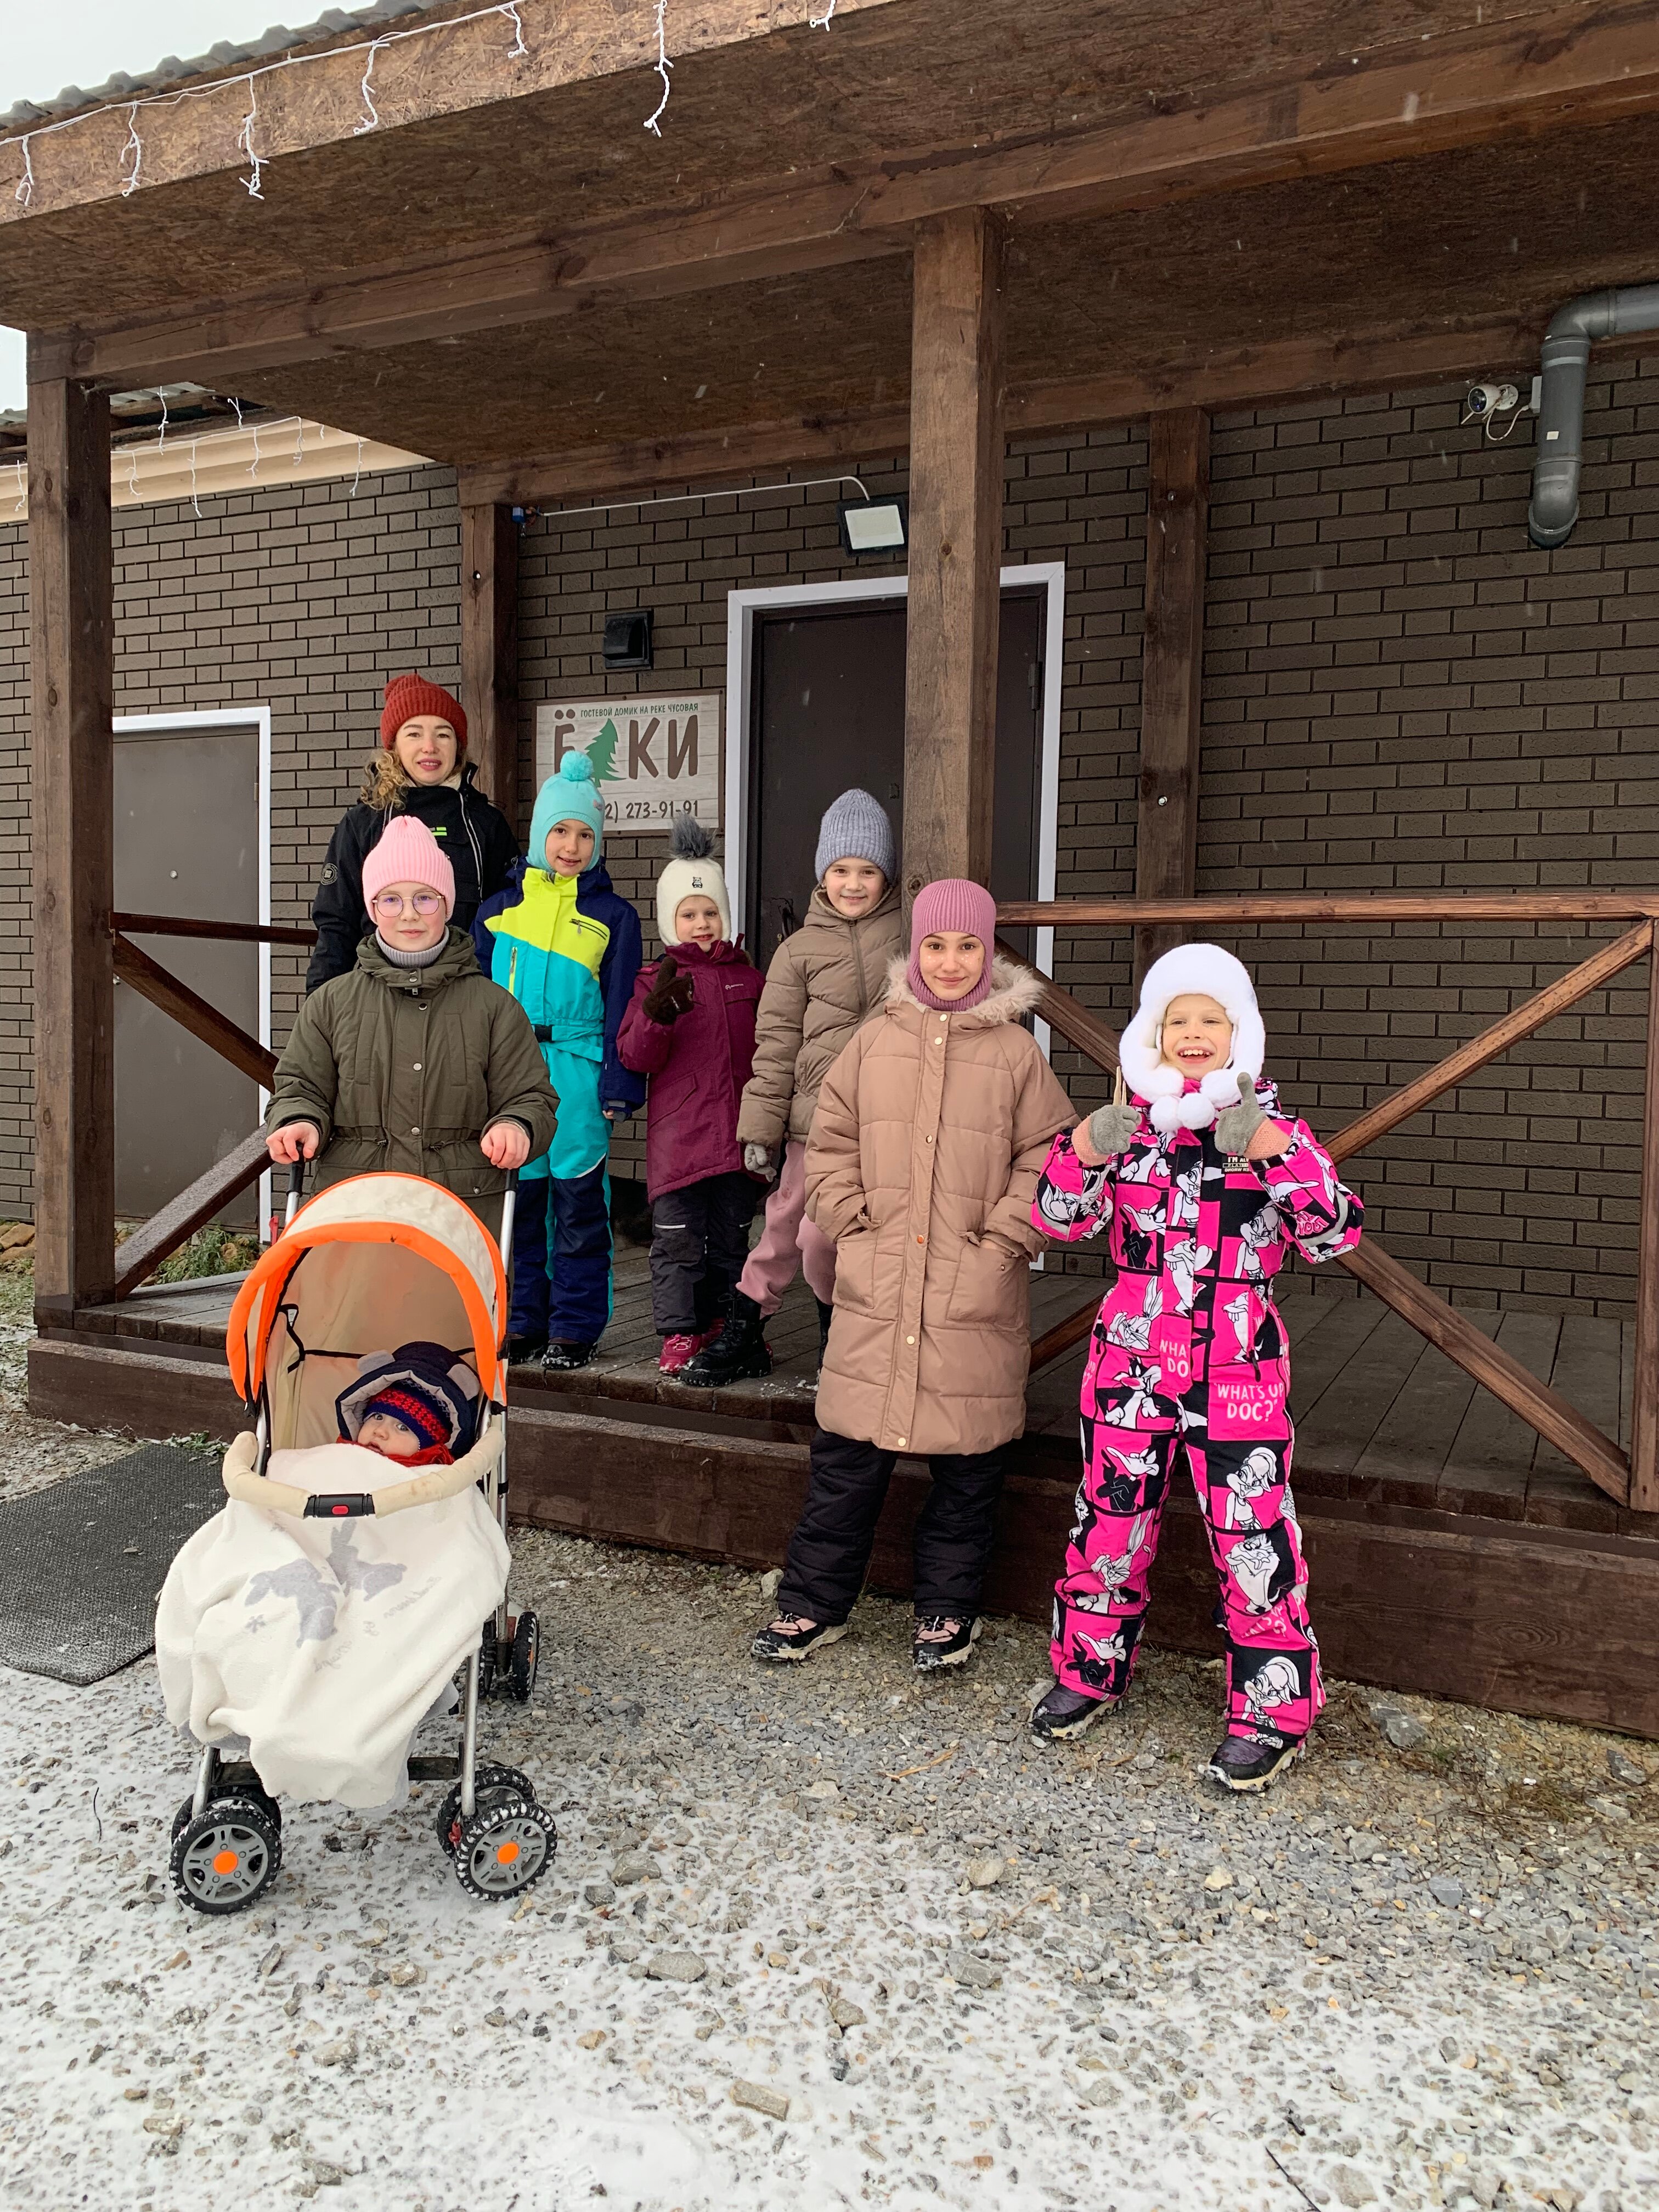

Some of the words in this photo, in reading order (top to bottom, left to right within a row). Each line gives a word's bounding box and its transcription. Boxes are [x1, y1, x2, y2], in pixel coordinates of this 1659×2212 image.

[581, 707, 612, 718] ГОСТЕВОЙ
[614, 706, 637, 716] ДОМИК
[640, 706, 648, 714] НА
[651, 705, 665, 713] РЕКЕ
[668, 703, 698, 713] ЧУСОВАЯ
[626, 800, 698, 819] 273-91-91
[1268, 1383, 1284, 1398] UP
